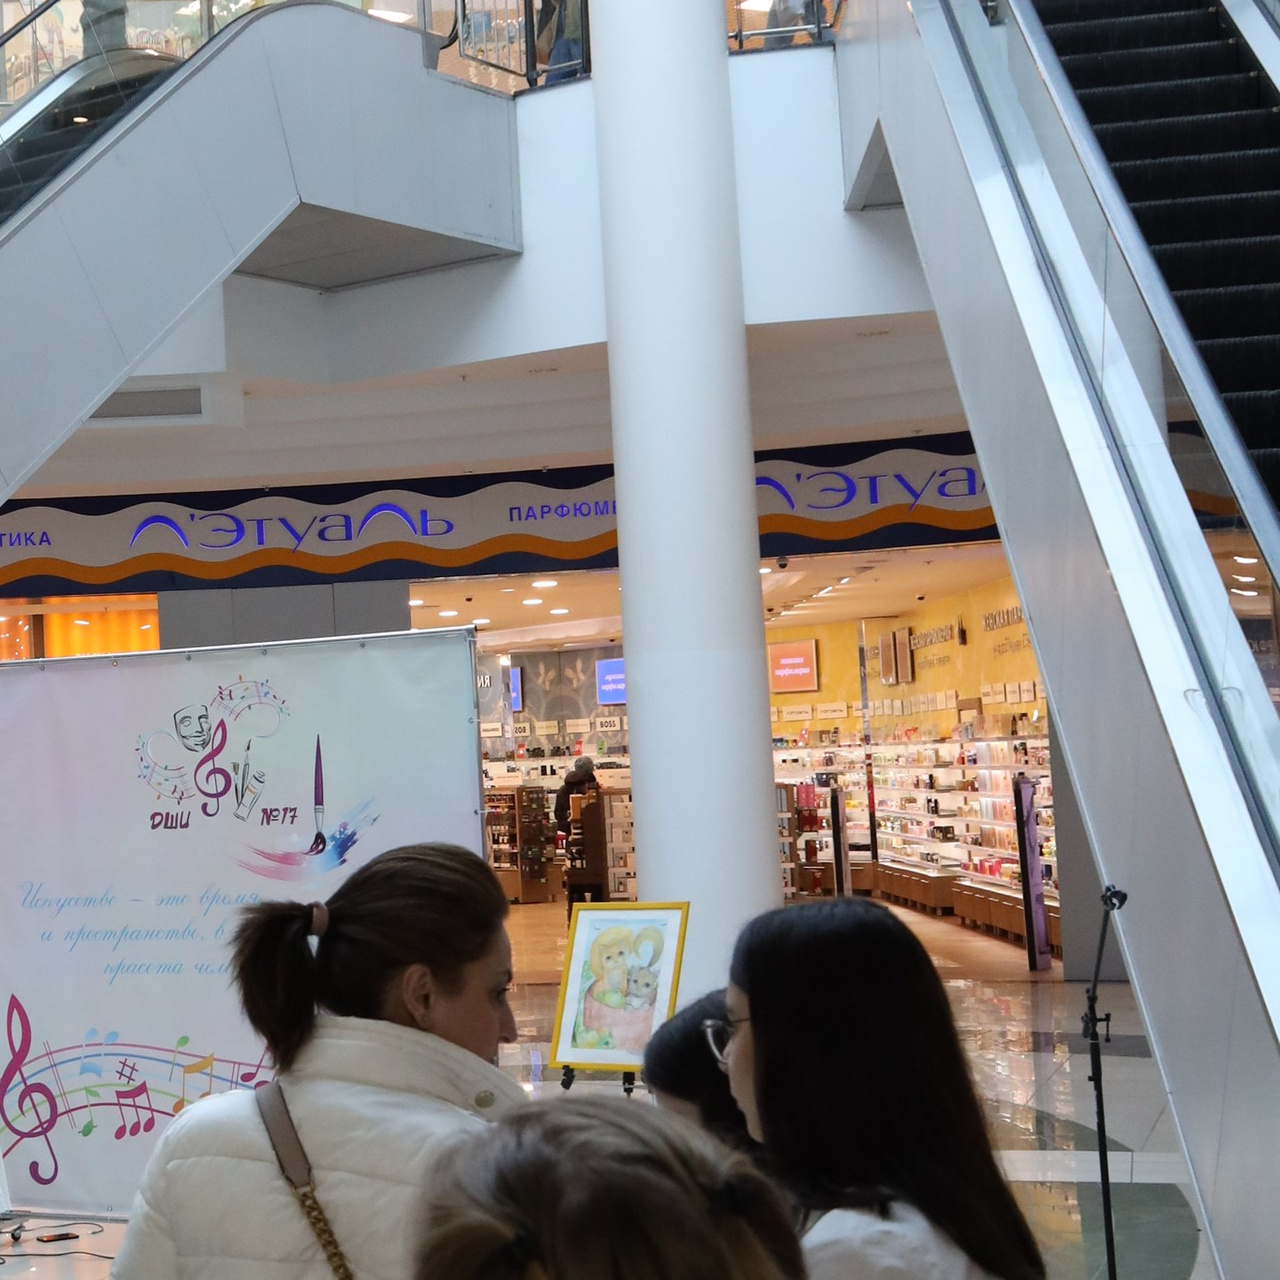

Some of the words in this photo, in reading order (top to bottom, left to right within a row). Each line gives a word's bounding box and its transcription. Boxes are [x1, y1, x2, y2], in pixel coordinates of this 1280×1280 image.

[756, 466, 986, 512] Л'Этуа
[509, 500, 617, 522] ПАРФЮМ
[599, 720, 616, 728] BOSS
[150, 811, 191, 830] ДШИ
[260, 807, 298, 826] №17
[19, 880, 116, 919] Искусство
[156, 894, 190, 907] это
[199, 883, 261, 916] время
[40, 930, 53, 942] и
